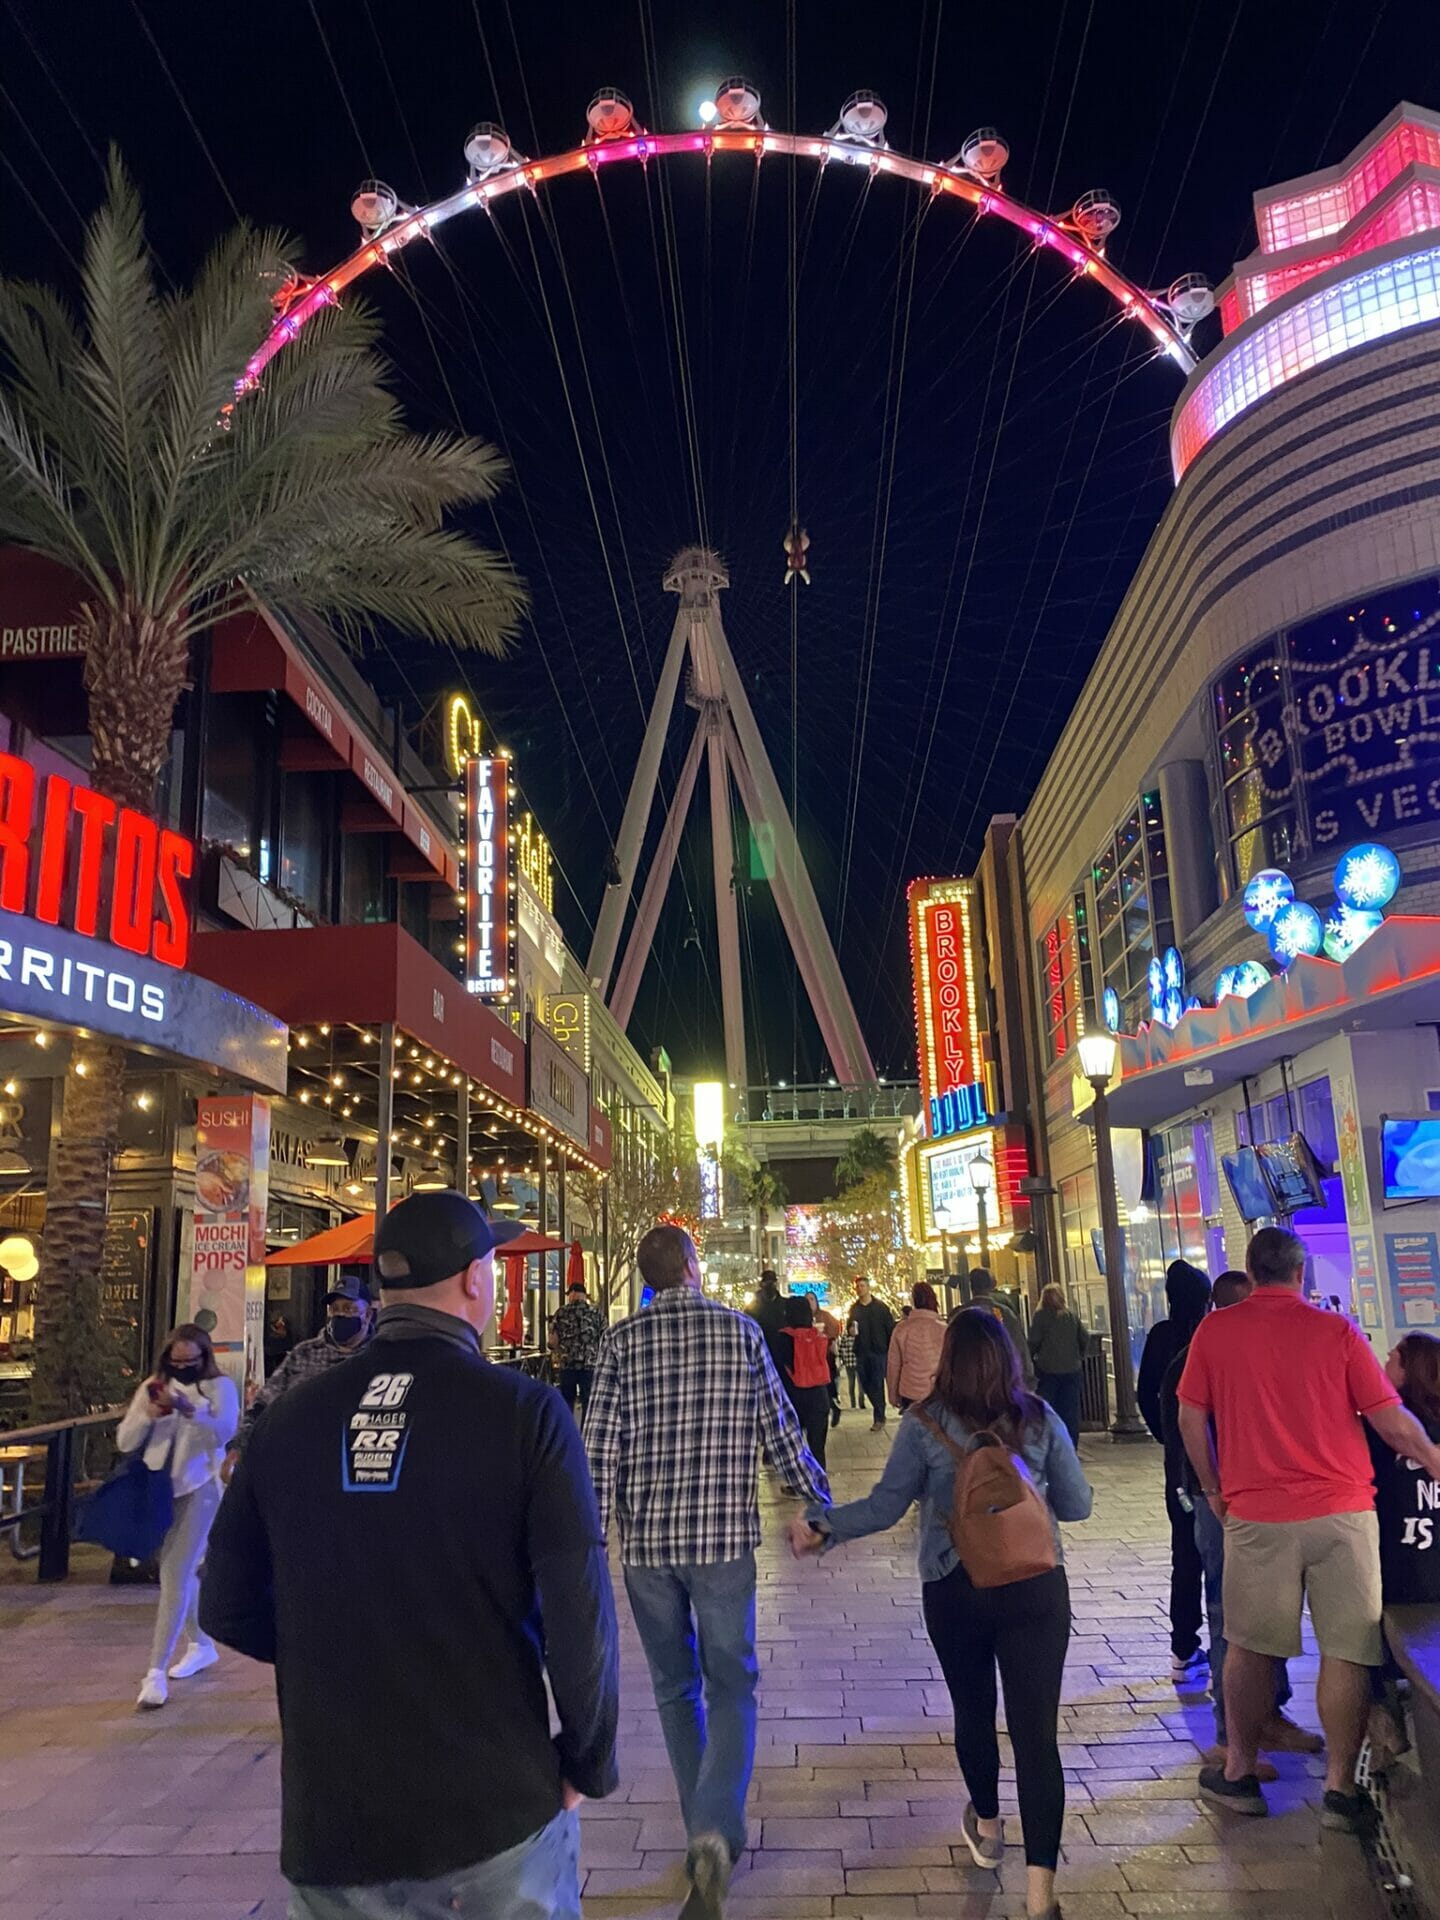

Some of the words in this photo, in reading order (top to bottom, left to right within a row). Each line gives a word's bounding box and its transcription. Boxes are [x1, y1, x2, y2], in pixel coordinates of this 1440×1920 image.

[477, 760, 495, 978] FAVORITE
[467, 979, 505, 993] BISTRO
[934, 909, 968, 1095] BROOKLY
[201, 1112, 249, 1128] SUSHI
[195, 1225, 246, 1242] MOCHI
[195, 1242, 210, 1251] ICE
[212, 1240, 246, 1251] CREAM
[193, 1252, 246, 1272] POPS
[359, 1374, 414, 1409] 26
[351, 1431, 400, 1451] RR
[1401, 1517, 1434, 1550] IS
